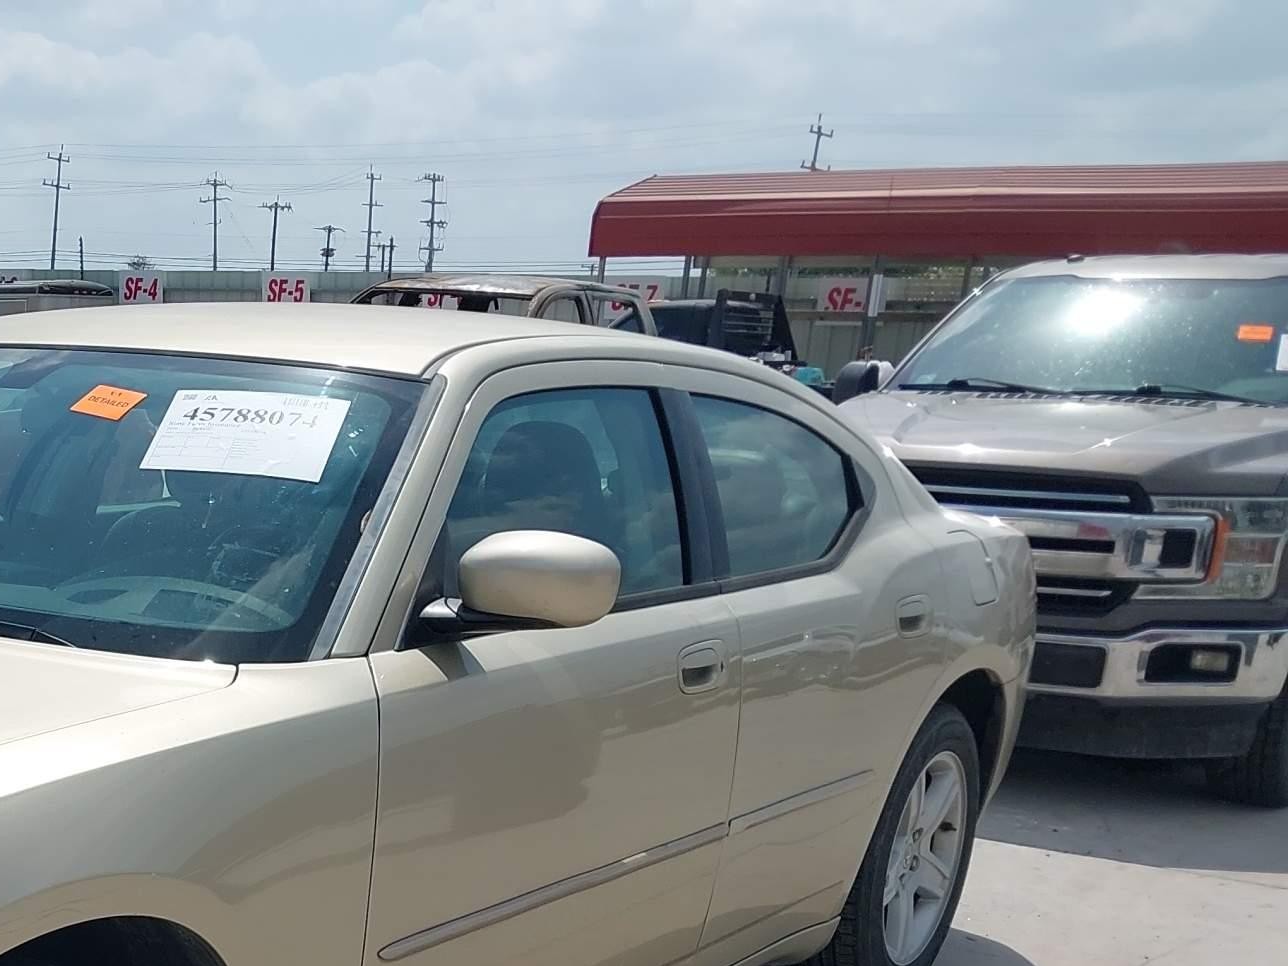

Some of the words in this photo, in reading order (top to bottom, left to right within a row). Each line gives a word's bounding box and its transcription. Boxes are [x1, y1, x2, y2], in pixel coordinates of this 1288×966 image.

[123, 277, 159, 301] SF-4
[267, 279, 305, 303] SF-5
[88, 395, 129, 408] DETAILED
[182, 406, 318, 429] 45788074
